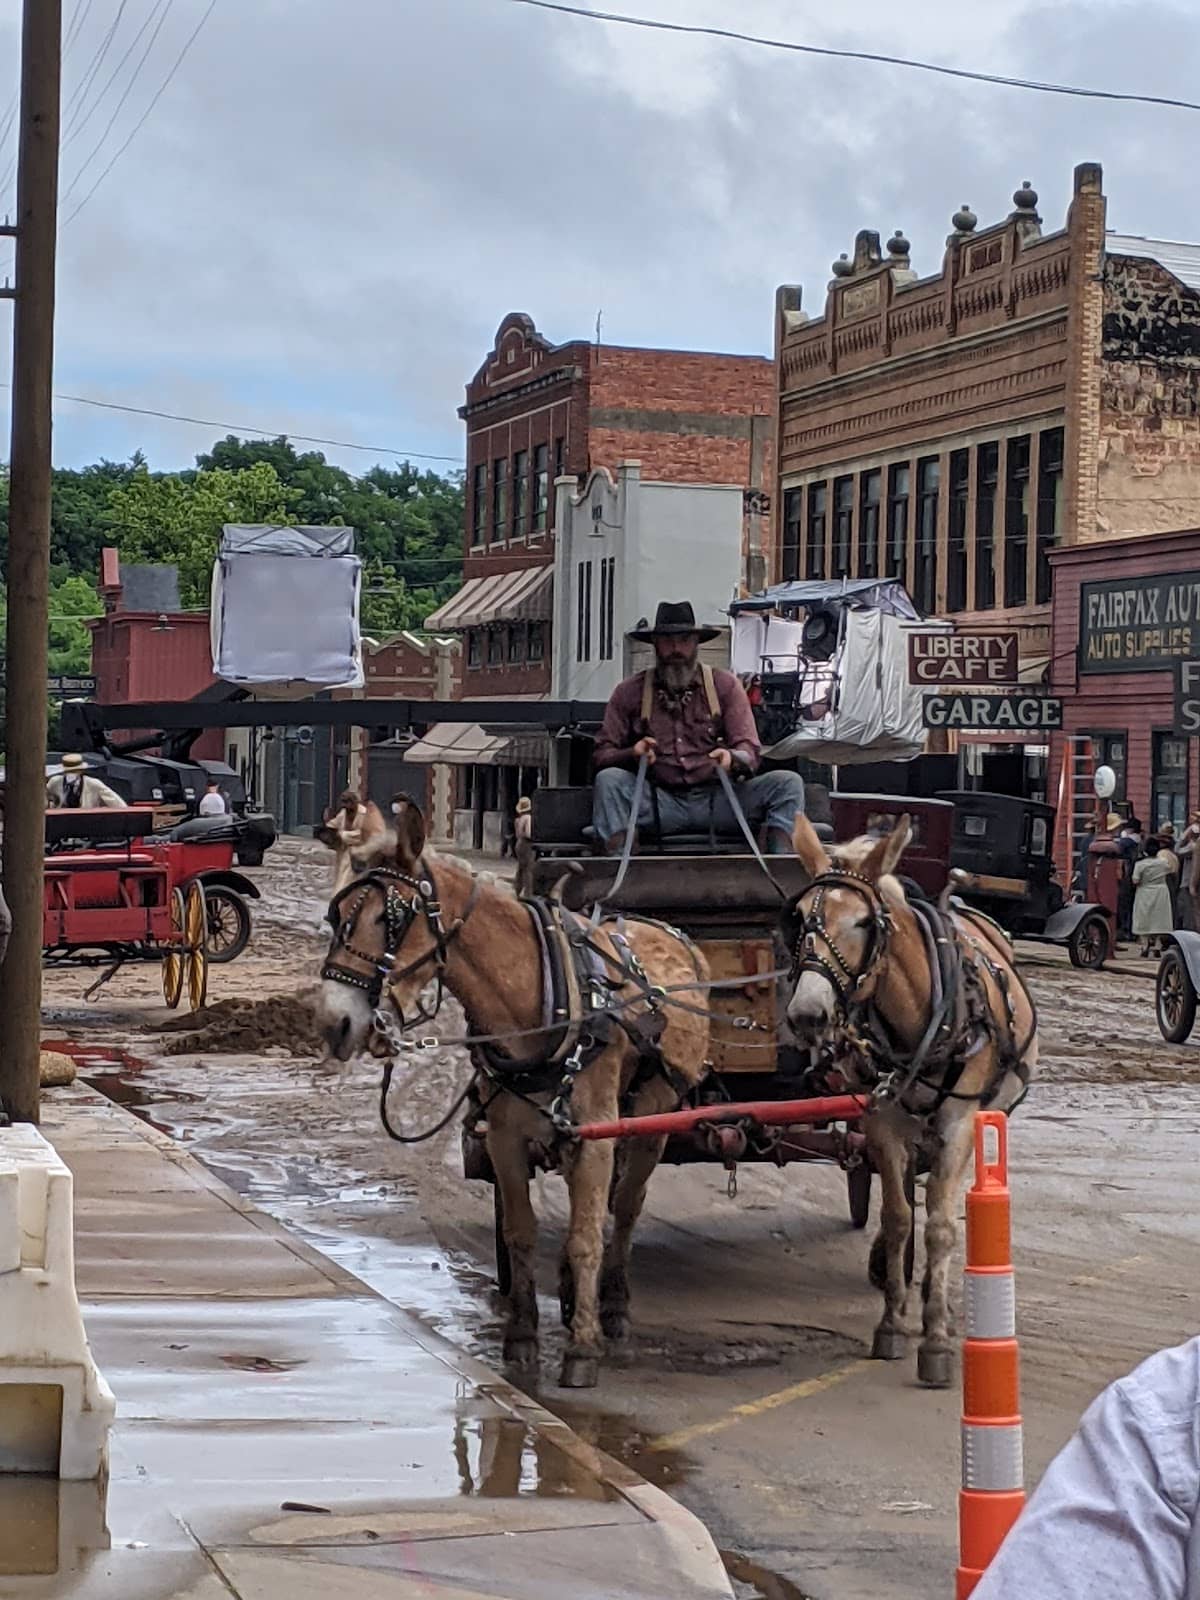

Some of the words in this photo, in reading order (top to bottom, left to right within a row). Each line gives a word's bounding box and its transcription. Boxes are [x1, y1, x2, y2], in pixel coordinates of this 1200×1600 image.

[1087, 588, 1160, 629] FAIRFAX
[913, 635, 1014, 659] LIBERTY
[1087, 632, 1121, 660] AUTO
[1126, 626, 1192, 659] SUPPLIES
[916, 658, 1009, 680] CAFE
[925, 698, 1062, 726] GARAGE
